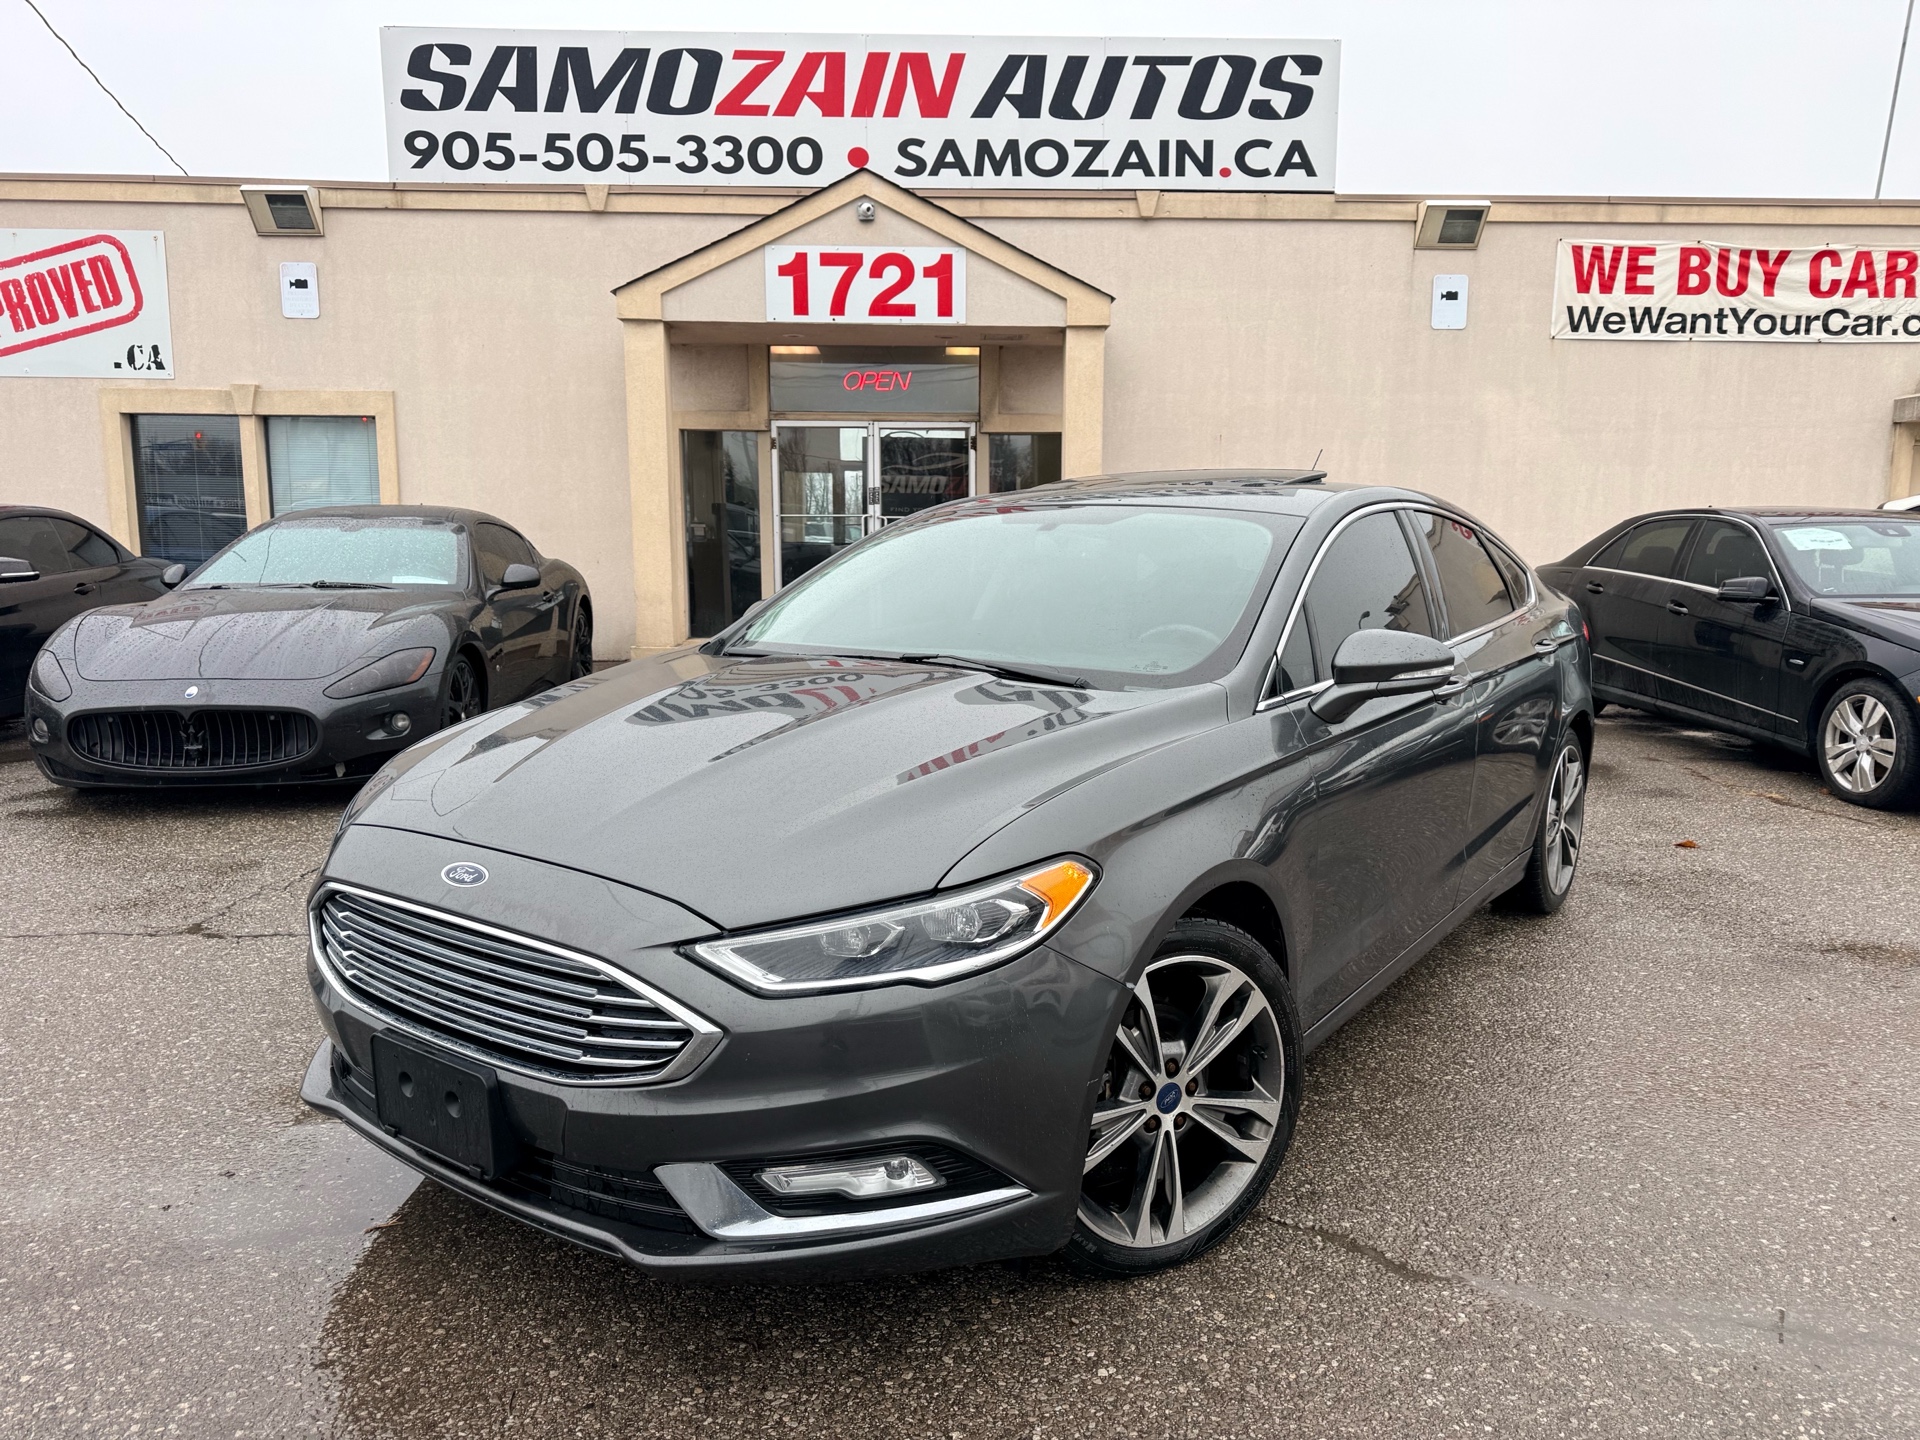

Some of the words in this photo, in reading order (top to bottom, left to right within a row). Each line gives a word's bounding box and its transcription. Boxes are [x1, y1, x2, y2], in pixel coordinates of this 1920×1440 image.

[400, 43, 966, 119] SAMOZAIN
[970, 54, 1323, 120] AUTOS
[403, 130, 823, 175] 905-505-3300
[894, 137, 1318, 178] SAMOZAIN.CA
[777, 251, 954, 318] 1721
[1571, 245, 1657, 296] WE
[1676, 246, 1793, 298] BUY
[1808, 249, 1919, 299] CAR
[113, 344, 166, 371] .CA
[842, 369, 913, 392] OPEN
[449, 866, 479, 882] Ford
